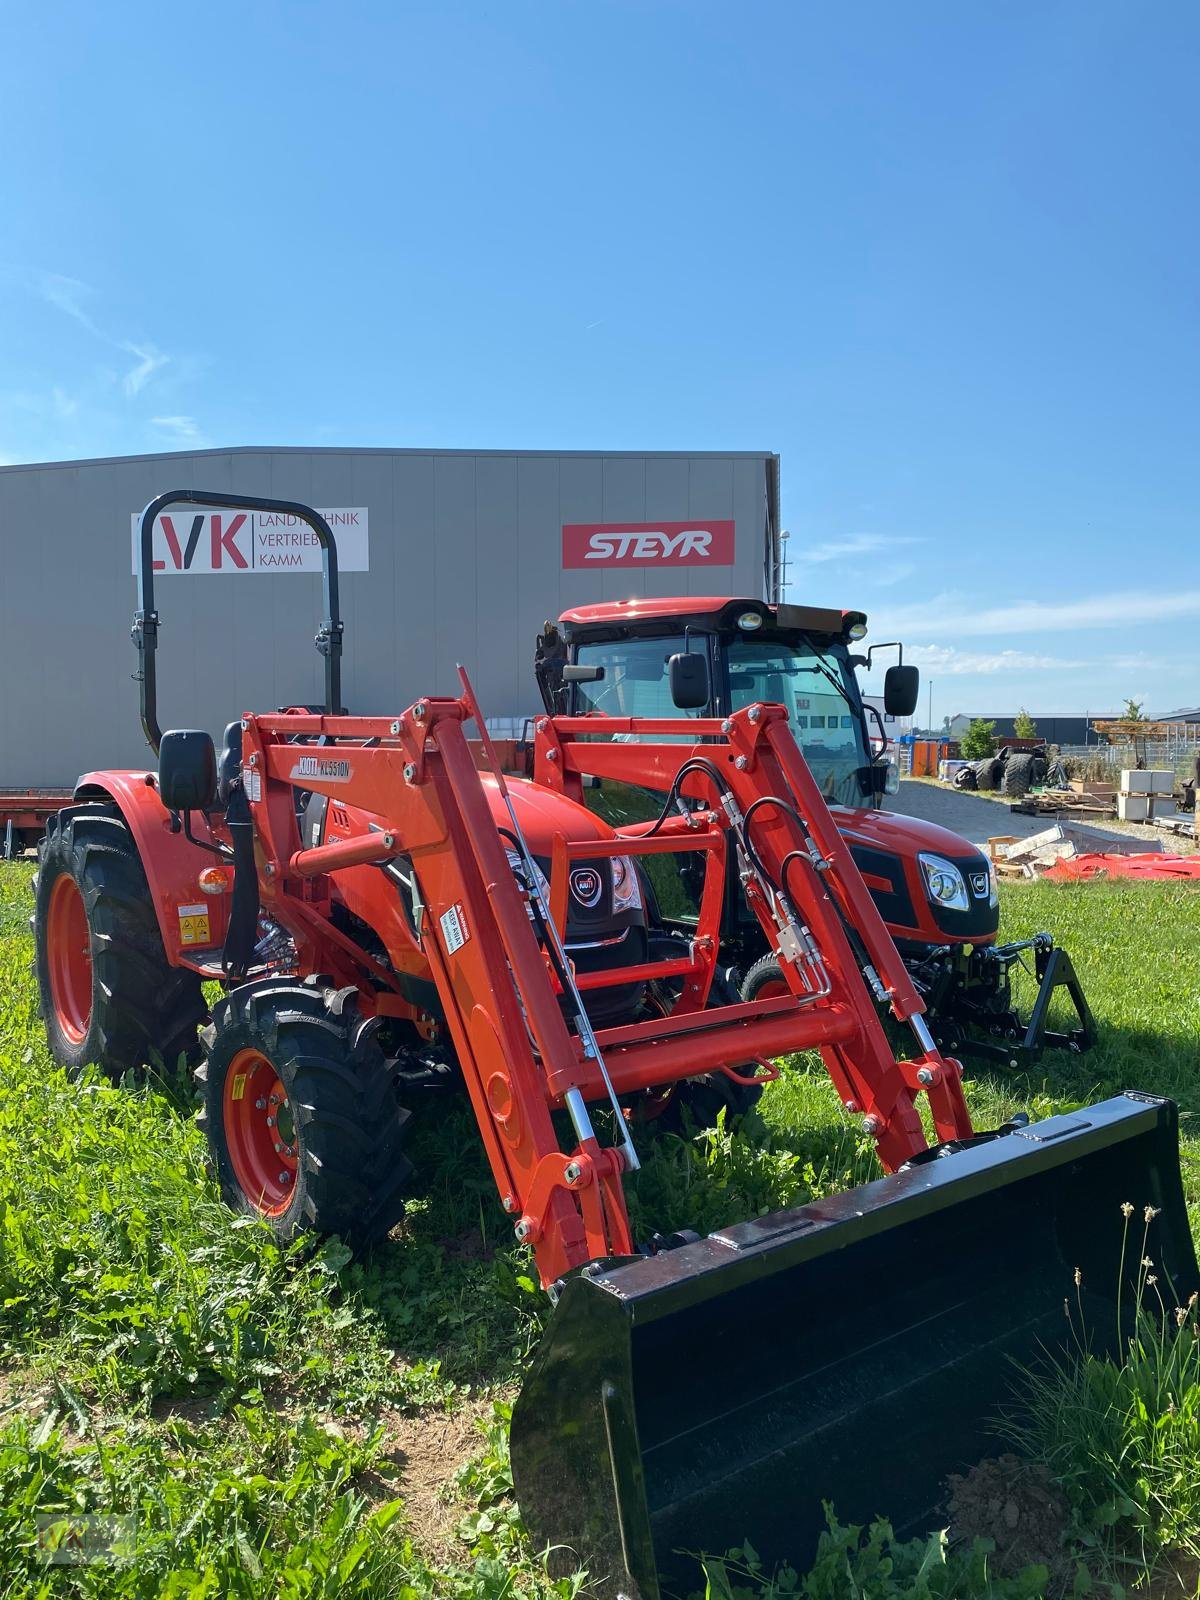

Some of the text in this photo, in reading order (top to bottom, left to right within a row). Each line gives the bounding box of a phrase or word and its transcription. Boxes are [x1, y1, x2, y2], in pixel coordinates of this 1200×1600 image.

[260, 513, 359, 526] LANDHNIK
[584, 530, 713, 559] STEYR
[260, 554, 302, 566] KAMM
[453, 926, 463, 946] AWAY
